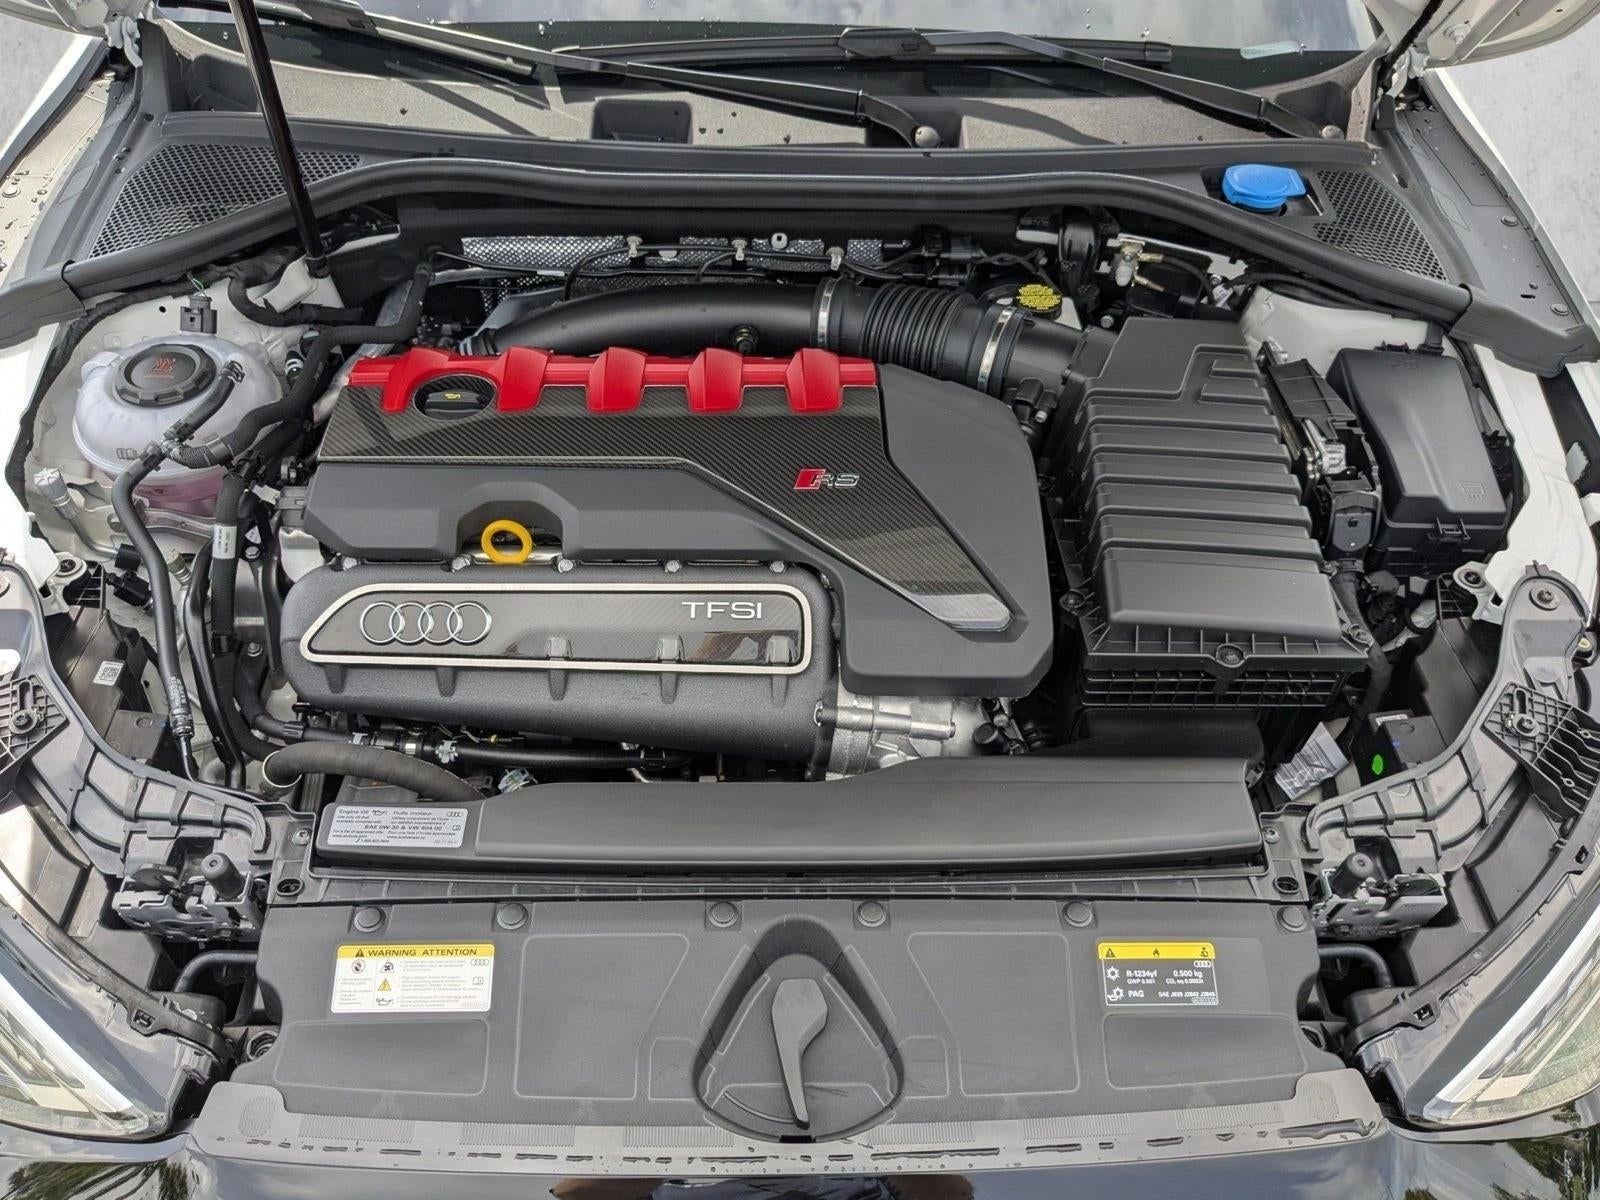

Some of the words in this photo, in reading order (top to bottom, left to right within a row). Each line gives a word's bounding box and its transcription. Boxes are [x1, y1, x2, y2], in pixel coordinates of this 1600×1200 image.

[806, 472, 860, 488] RS
[681, 602, 762, 619] TFSI
[368, 949, 416, 957] WARNING
[1126, 970, 1157, 978] R-1234yf
[1193, 970, 1203, 978] kg
